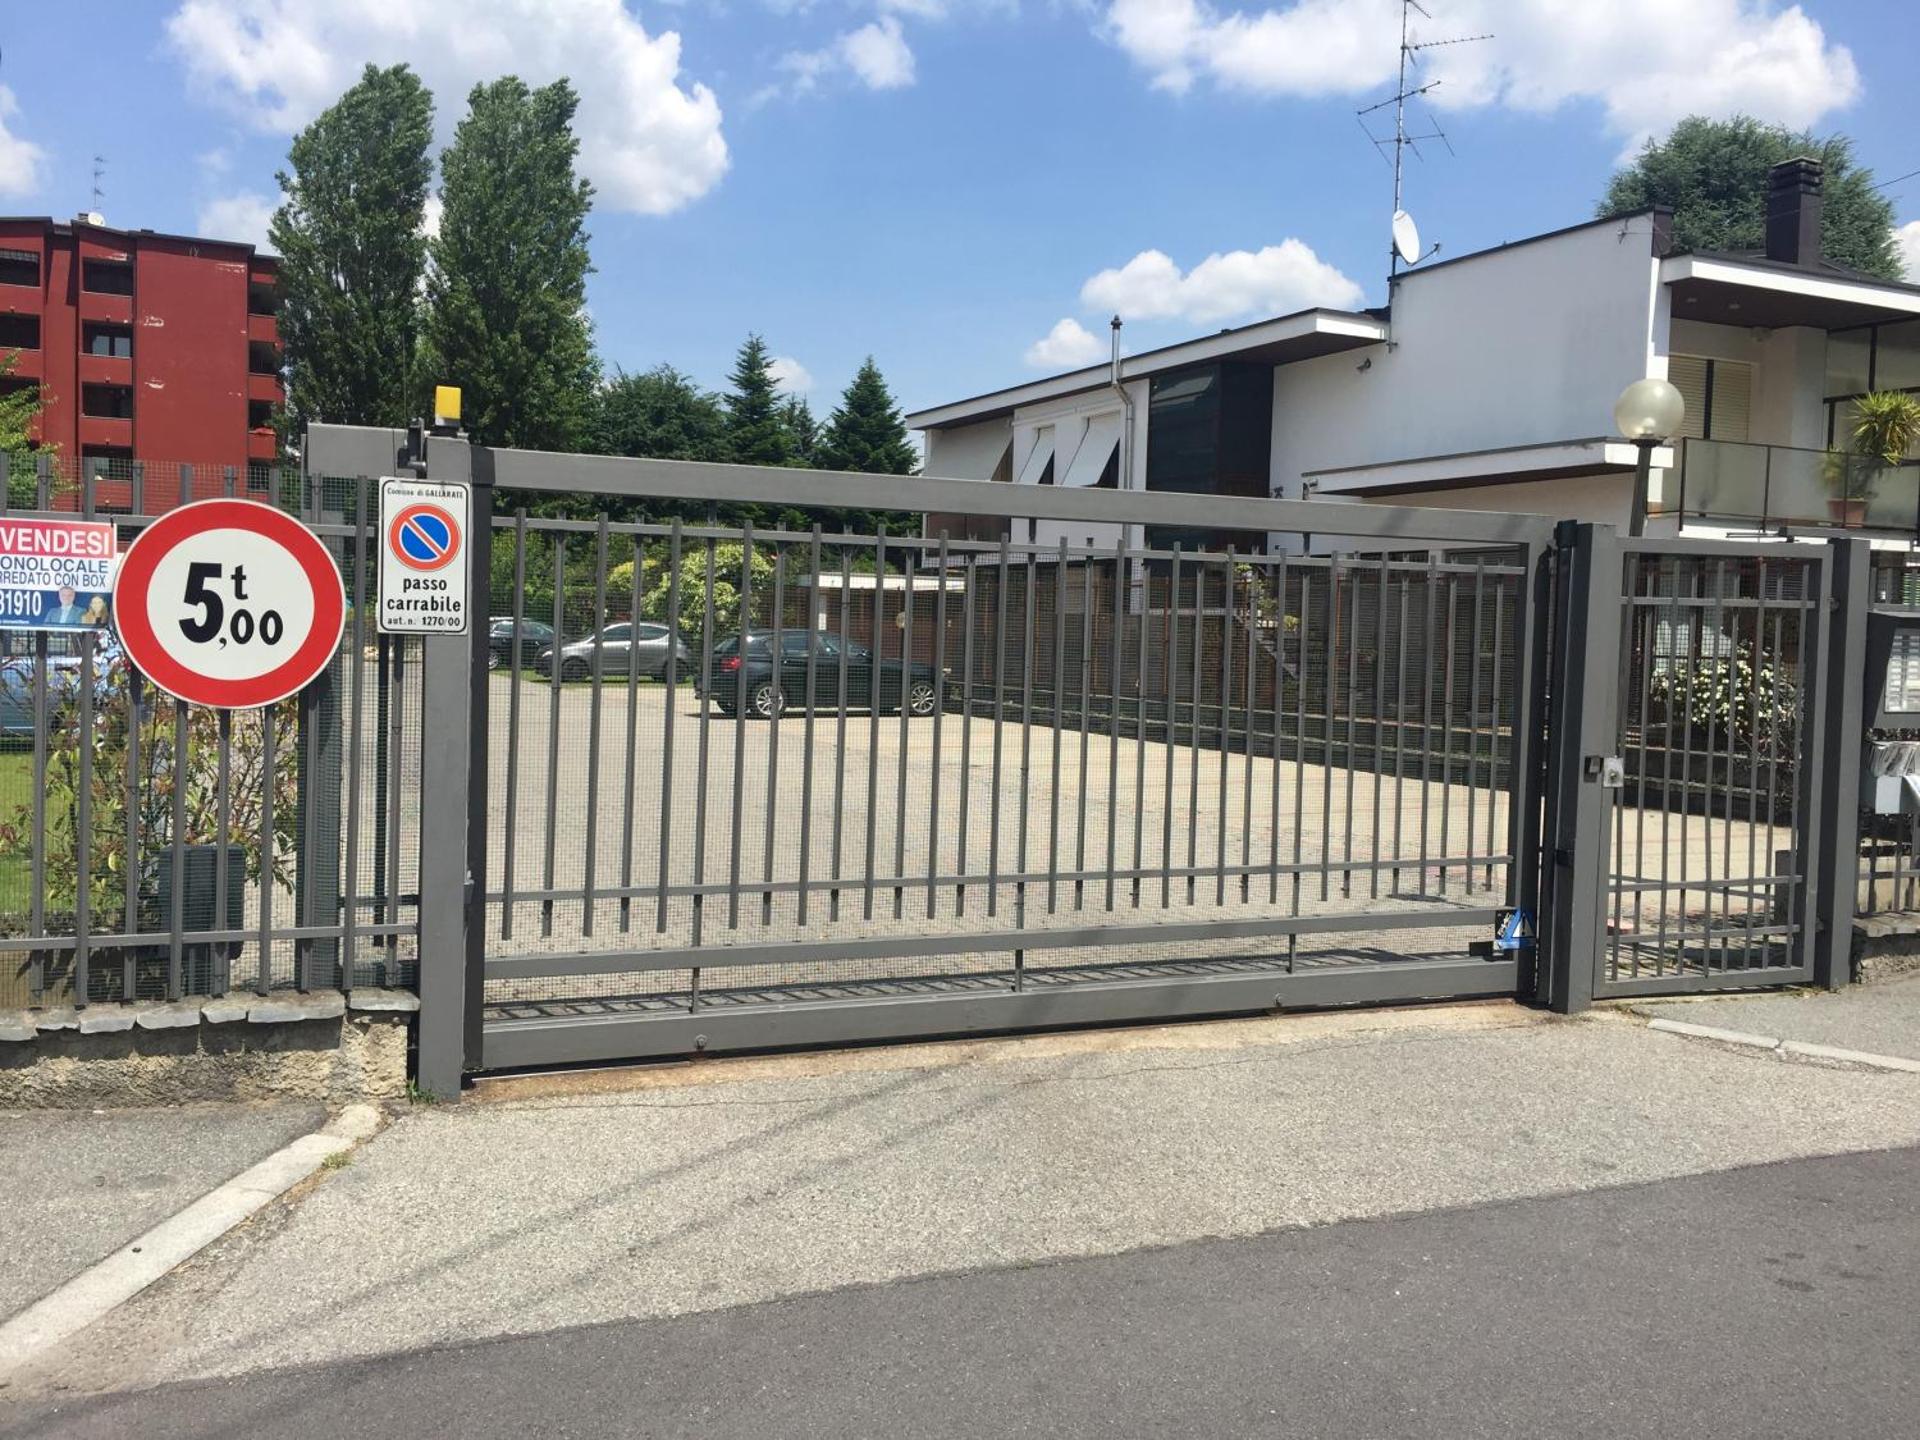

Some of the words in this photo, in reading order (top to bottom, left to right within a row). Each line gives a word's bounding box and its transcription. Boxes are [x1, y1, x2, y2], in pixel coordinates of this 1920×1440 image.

[425, 489, 464, 499] GALLARATE
[0, 527, 110, 555] VENDESI
[54, 573, 79, 586] CON
[82, 574, 106, 587] BOX
[230, 564, 248, 600] t
[403, 578, 447, 593] passo
[387, 595, 461, 612] carrabile
